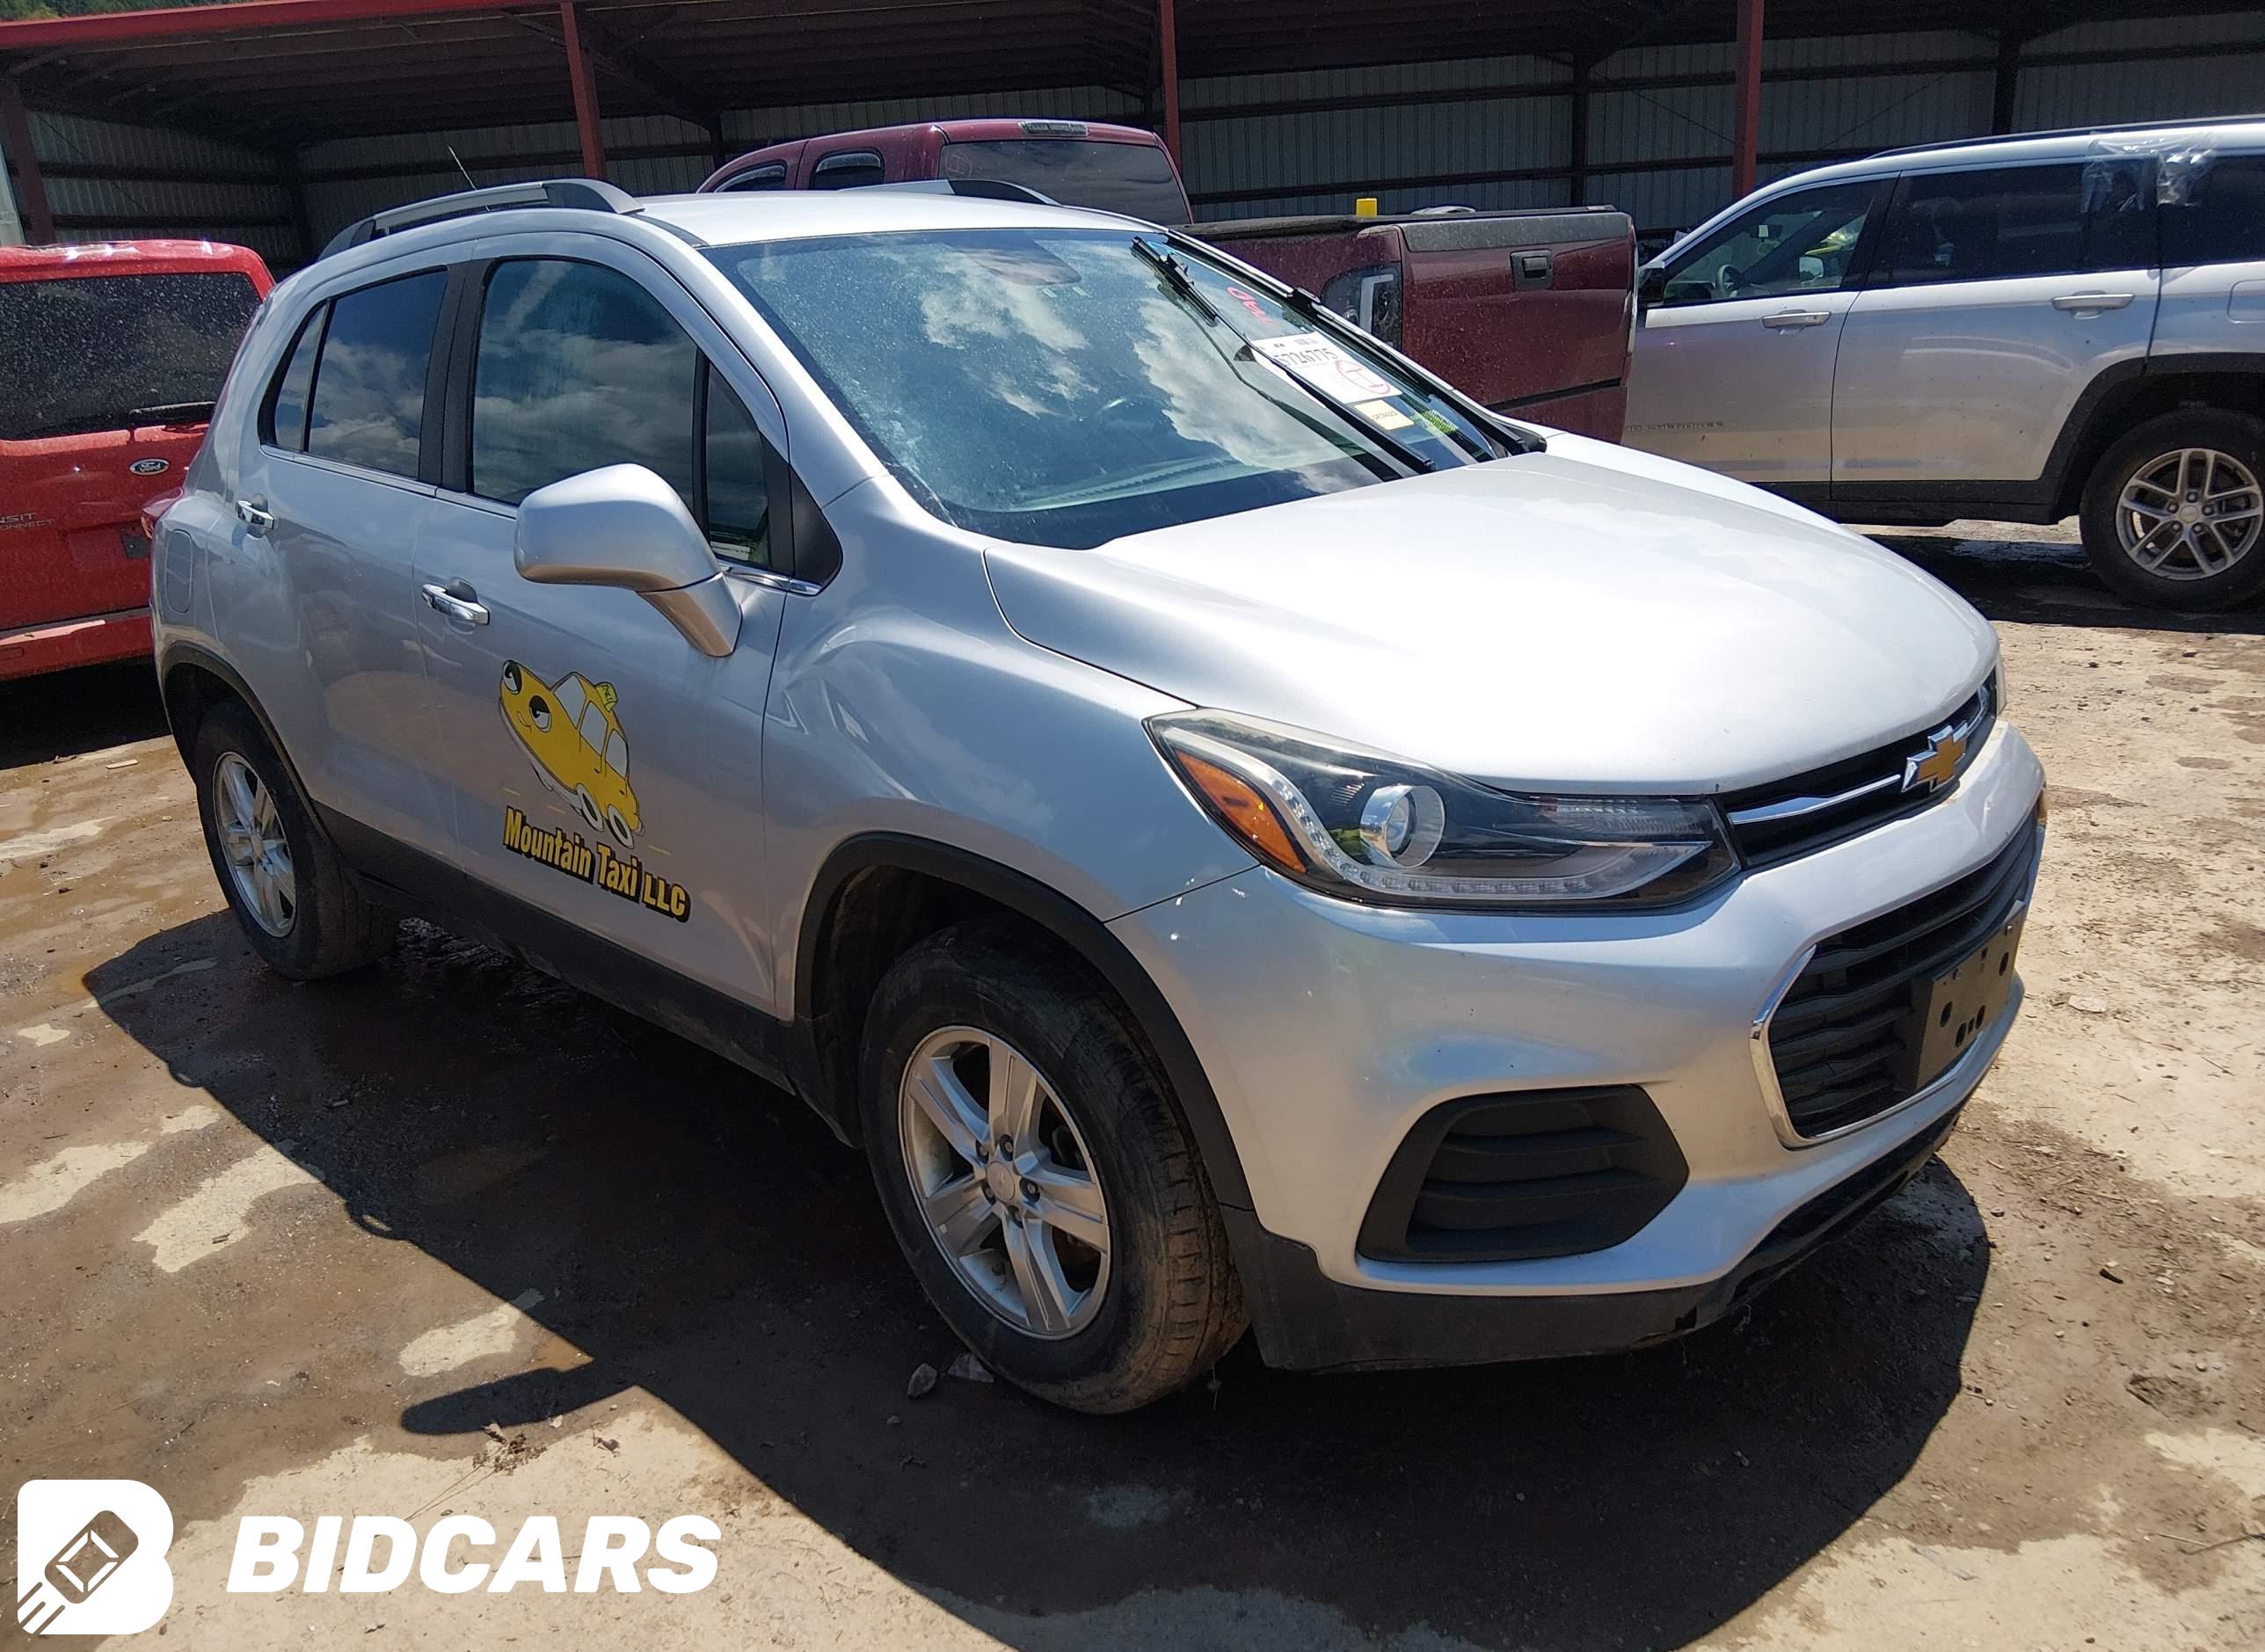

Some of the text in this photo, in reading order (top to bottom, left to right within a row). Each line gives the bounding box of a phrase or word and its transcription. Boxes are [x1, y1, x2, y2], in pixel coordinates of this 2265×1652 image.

[503, 805, 691, 922] Mountain Taxi LLC
